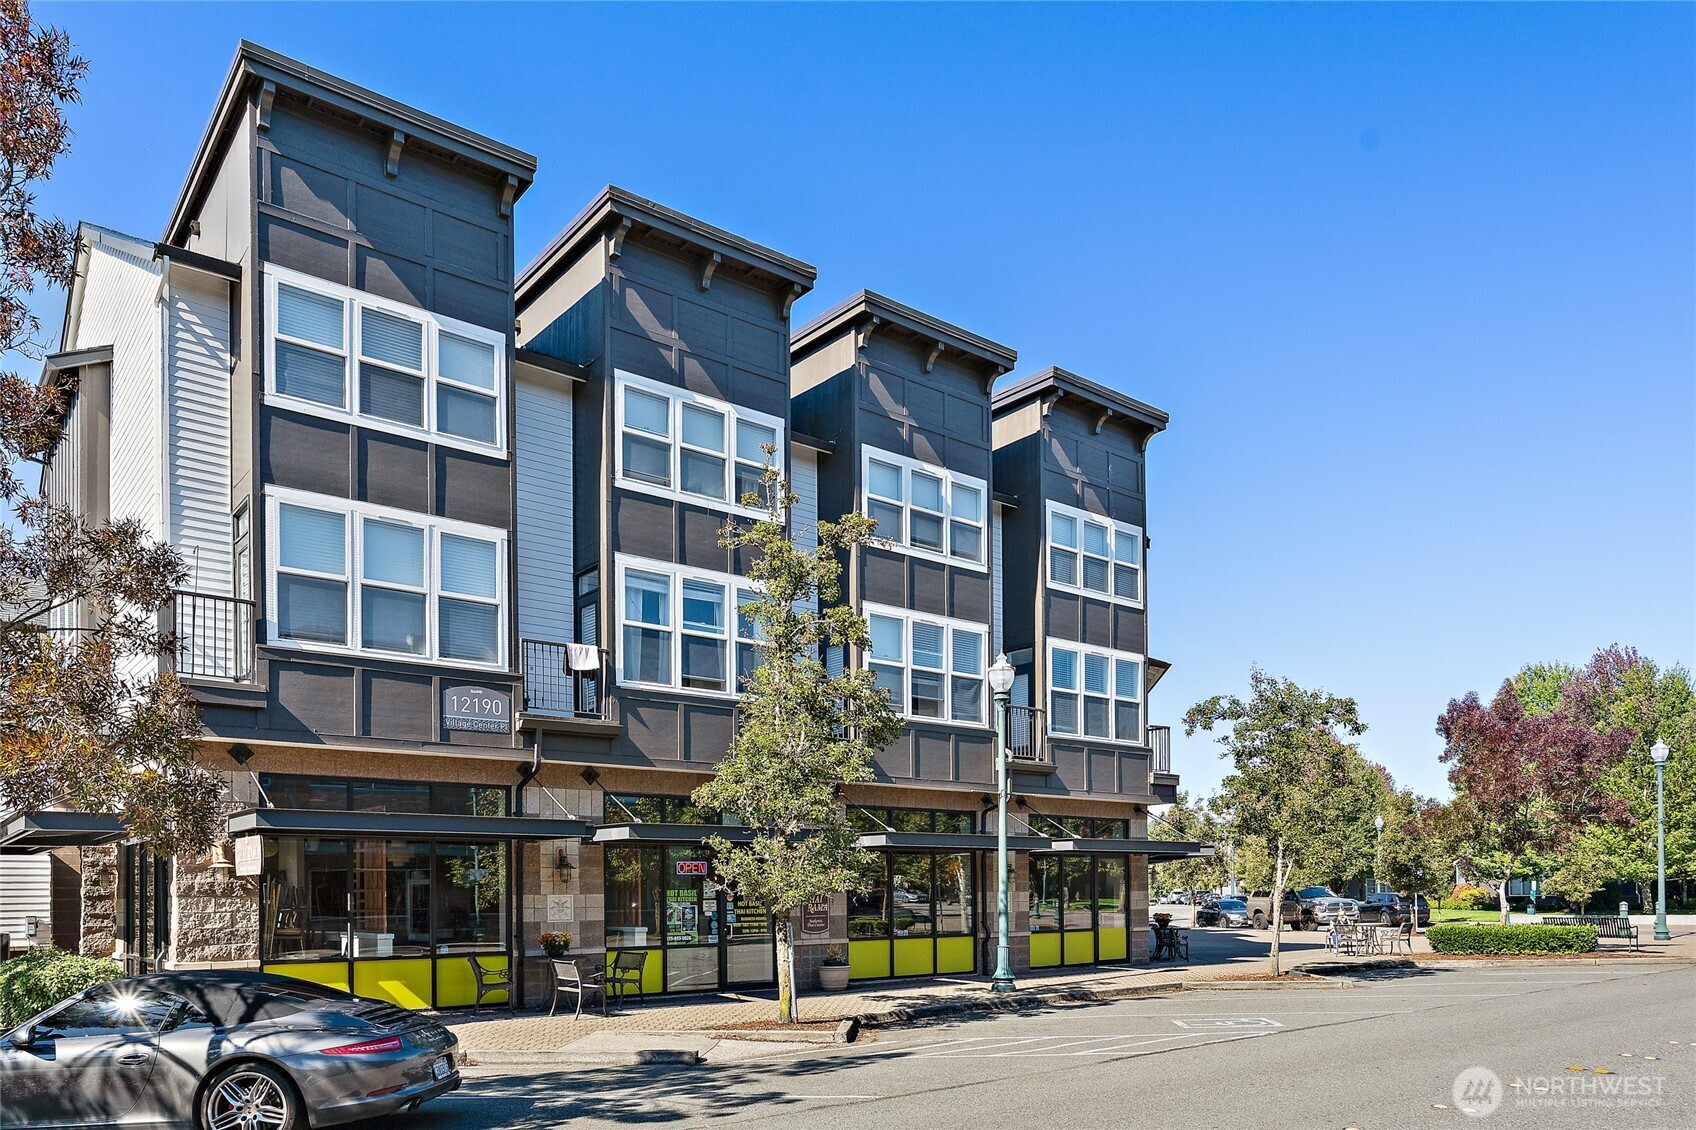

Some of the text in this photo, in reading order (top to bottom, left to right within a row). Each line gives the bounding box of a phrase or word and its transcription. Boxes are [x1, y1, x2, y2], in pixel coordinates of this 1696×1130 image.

[451, 696, 502, 715] 12190
[446, 719, 471, 728] Village
[473, 720, 497, 729] Center
[678, 863, 706, 873] OPEN
[807, 903, 828, 913] RAMA
